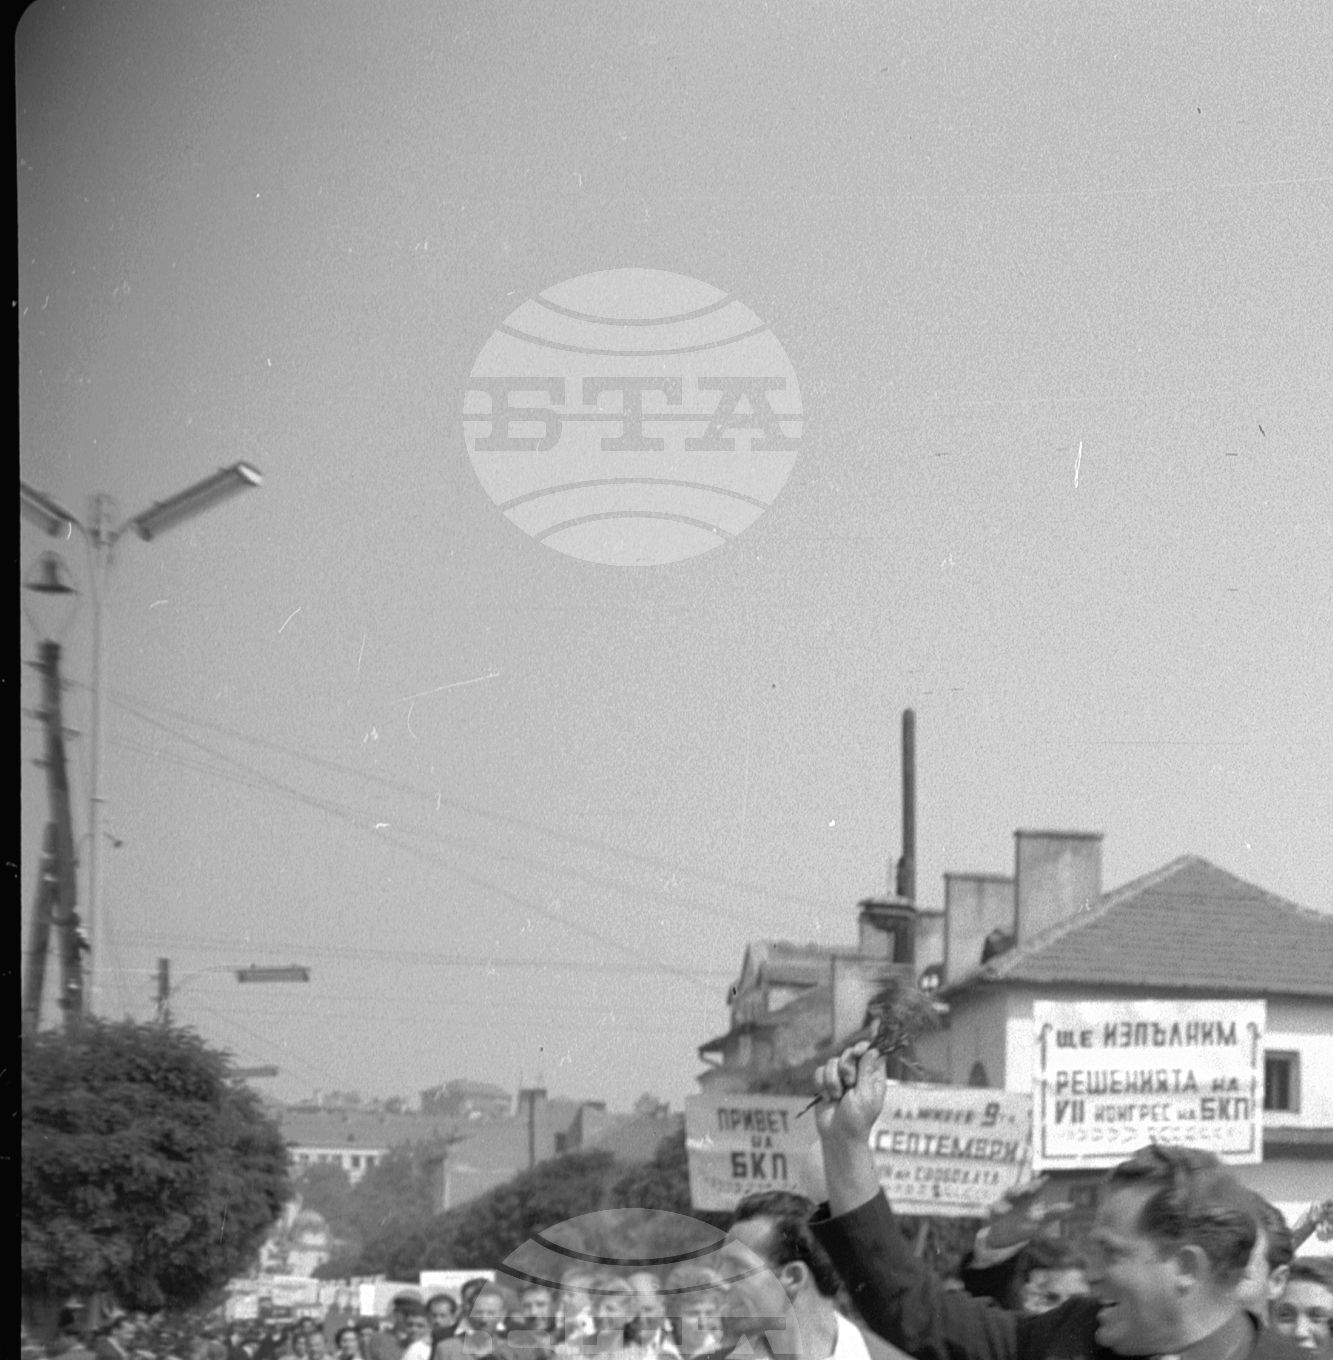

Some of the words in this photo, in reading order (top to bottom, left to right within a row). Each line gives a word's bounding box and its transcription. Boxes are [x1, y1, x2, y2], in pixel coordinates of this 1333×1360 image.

[1056, 1029, 1093, 1049] ЩЕ
[1103, 1020, 1238, 1048] ИЗПЪЛНИМ
[1055, 1069, 1200, 1096] РЕШЕНИЯТА
[1212, 1077, 1241, 1093] НА
[717, 1107, 790, 1134] ПРИВЕТ
[1199, 1097, 1250, 1122] БКП
[751, 1135, 773, 1148] НА
[874, 1128, 1019, 1164] СЕПТЕМВРИ
[730, 1151, 788, 1180] БКП
